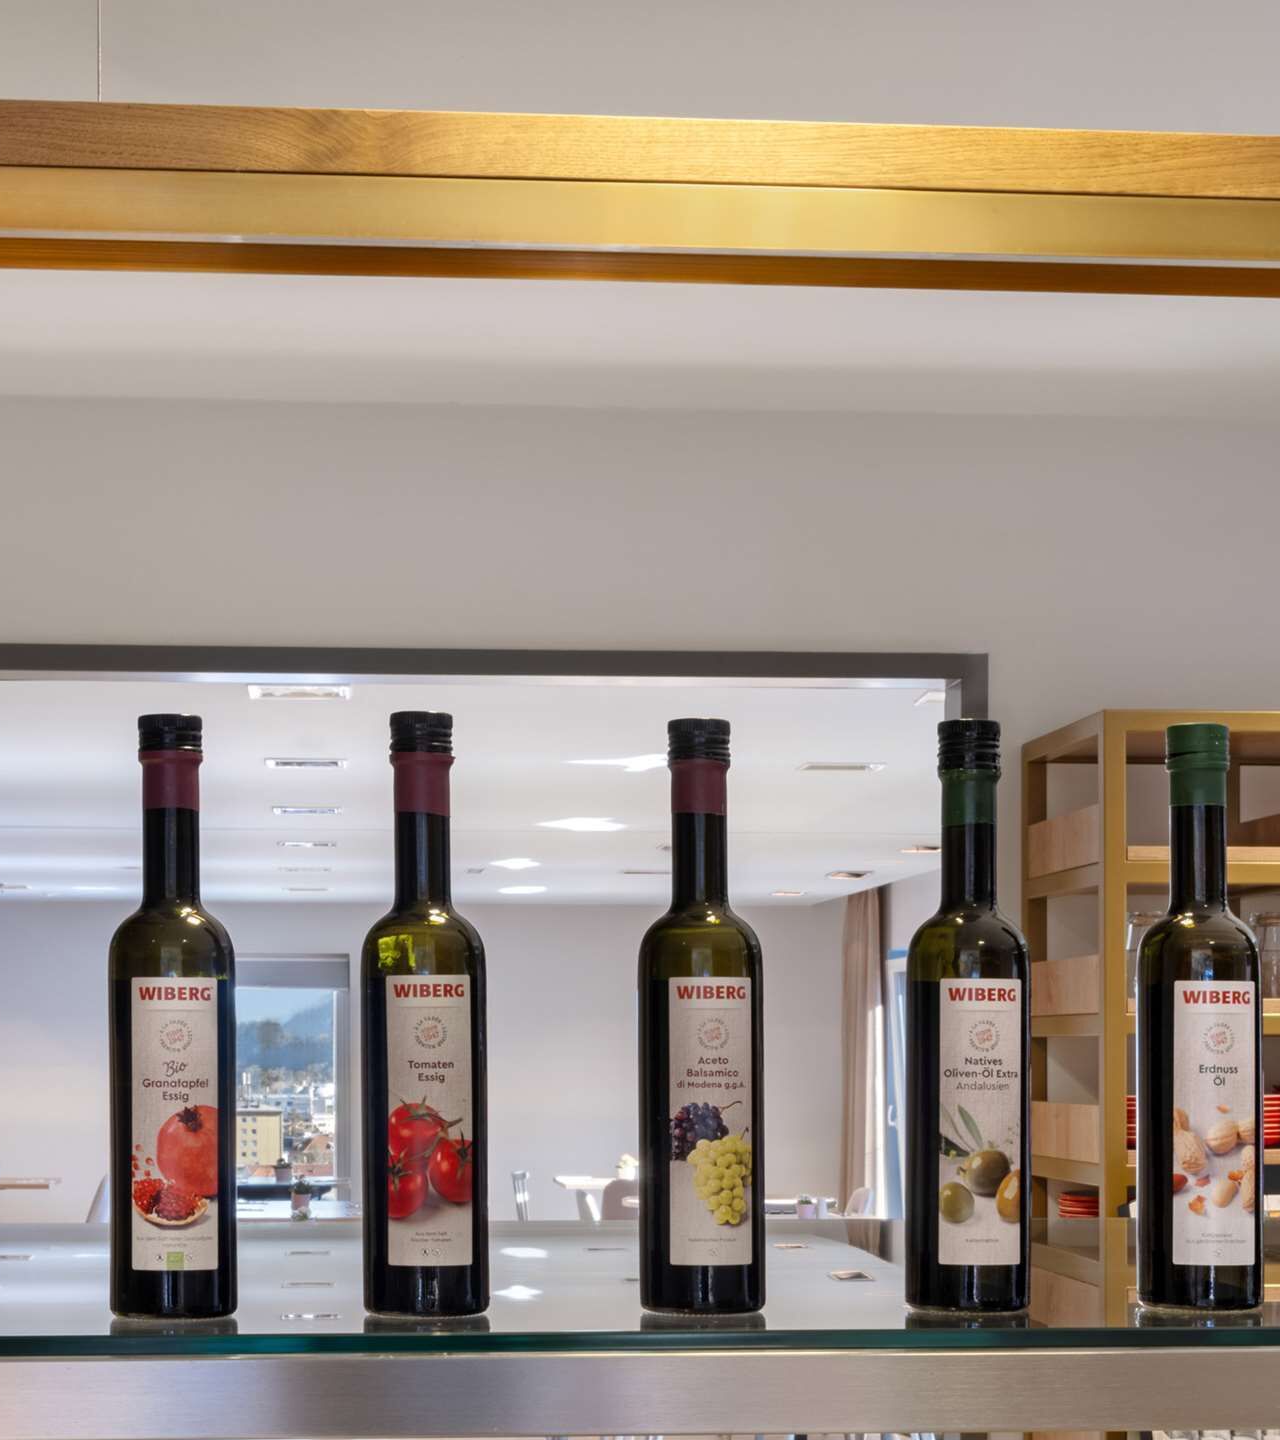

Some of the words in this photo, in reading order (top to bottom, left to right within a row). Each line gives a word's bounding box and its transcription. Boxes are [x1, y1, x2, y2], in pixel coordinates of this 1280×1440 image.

[139, 987, 211, 1001] WIBERG
[393, 983, 465, 998] WIBERG
[677, 985, 746, 1000] WIBERG
[948, 987, 1016, 1002] WIBERG
[1183, 990, 1251, 1004] WIBERG
[408, 1060, 455, 1070] Tomaten
[698, 1056, 729, 1065] Aceto
[964, 1056, 1003, 1066] Natives
[162, 1060, 189, 1077] Bio
[686, 1068, 739, 1078] Balsamico
[943, 1067, 994, 1079] Oliven-Öl
[996, 1069, 1018, 1079] Extra
[1199, 1064, 1239, 1074] Erdnuss
[142, 1078, 209, 1089] Granatapfel
[417, 1073, 446, 1084] Essig
[1213, 1076, 1226, 1087] Öl
[956, 1081, 1010, 1090] Andalusien
[162, 1092, 190, 1103] Essig
